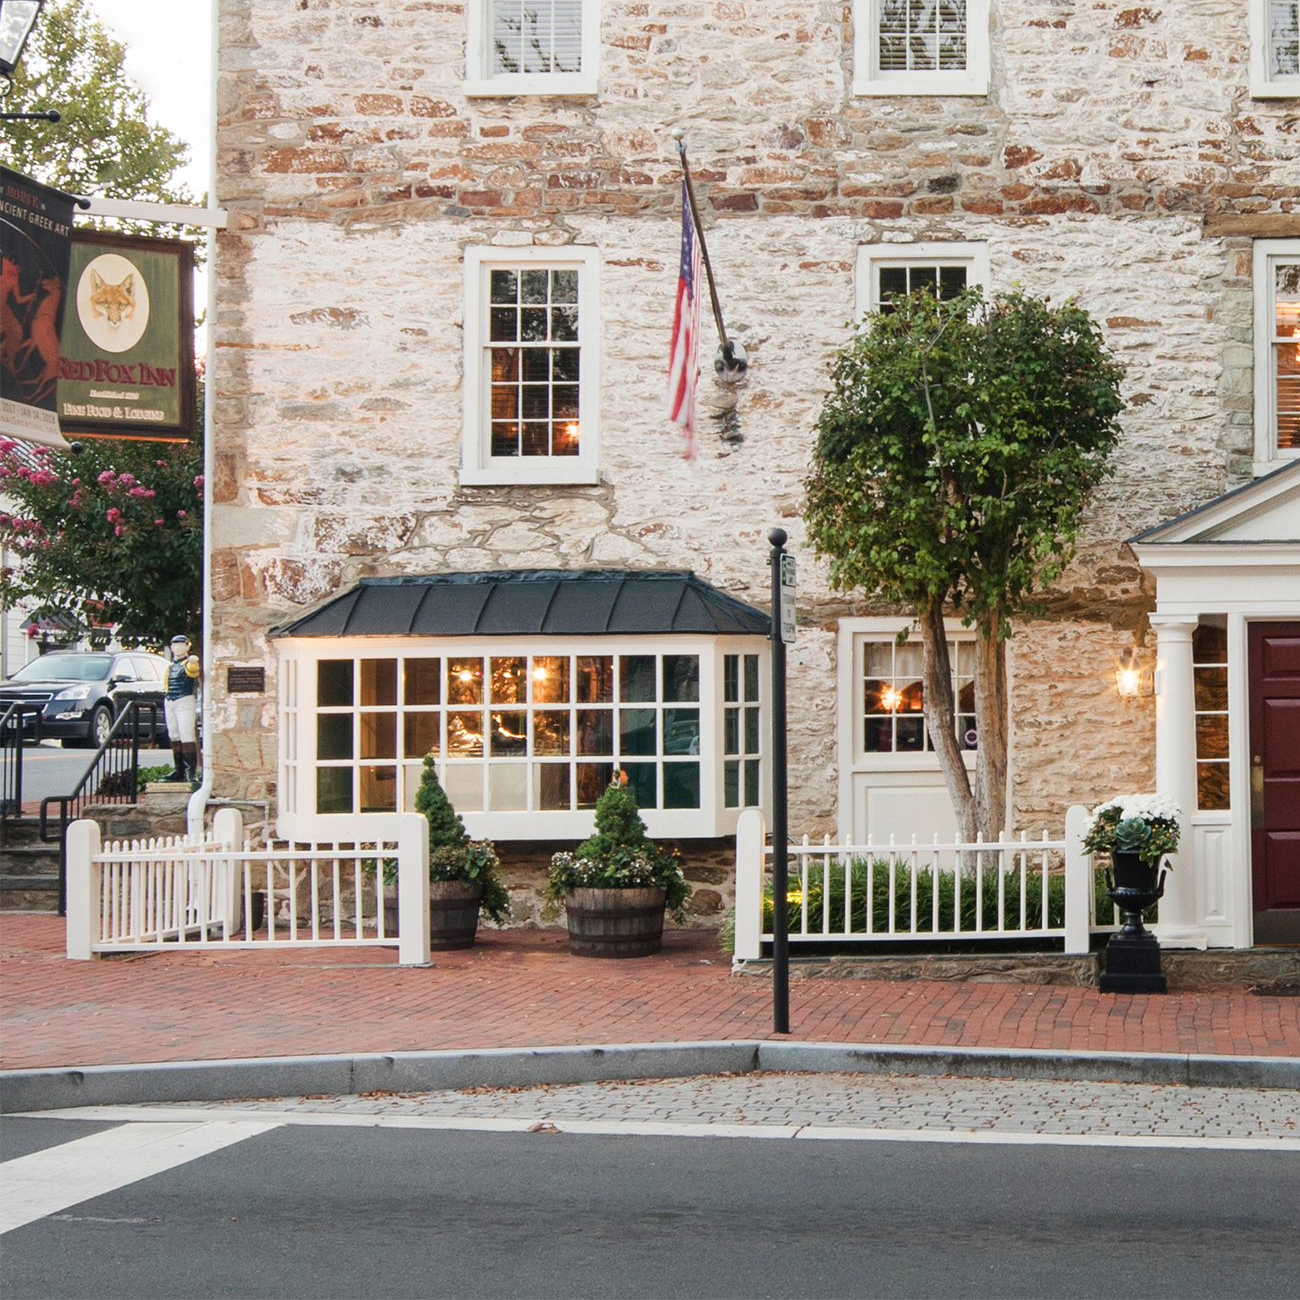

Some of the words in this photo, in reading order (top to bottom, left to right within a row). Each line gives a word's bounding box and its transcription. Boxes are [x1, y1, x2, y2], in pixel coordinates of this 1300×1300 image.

[6, 185, 39, 208] HORSE
[28, 212, 53, 230] GREEK
[54, 223, 70, 237] ART
[58, 356, 96, 381] RED
[94, 358, 136, 384] FOX
[138, 362, 177, 387] INN
[20, 406, 32, 417] JAN
[63, 403, 86, 416] FINE
[86, 404, 112, 418] FOOD
[112, 406, 124, 418] &
[124, 406, 165, 421] LODGING
